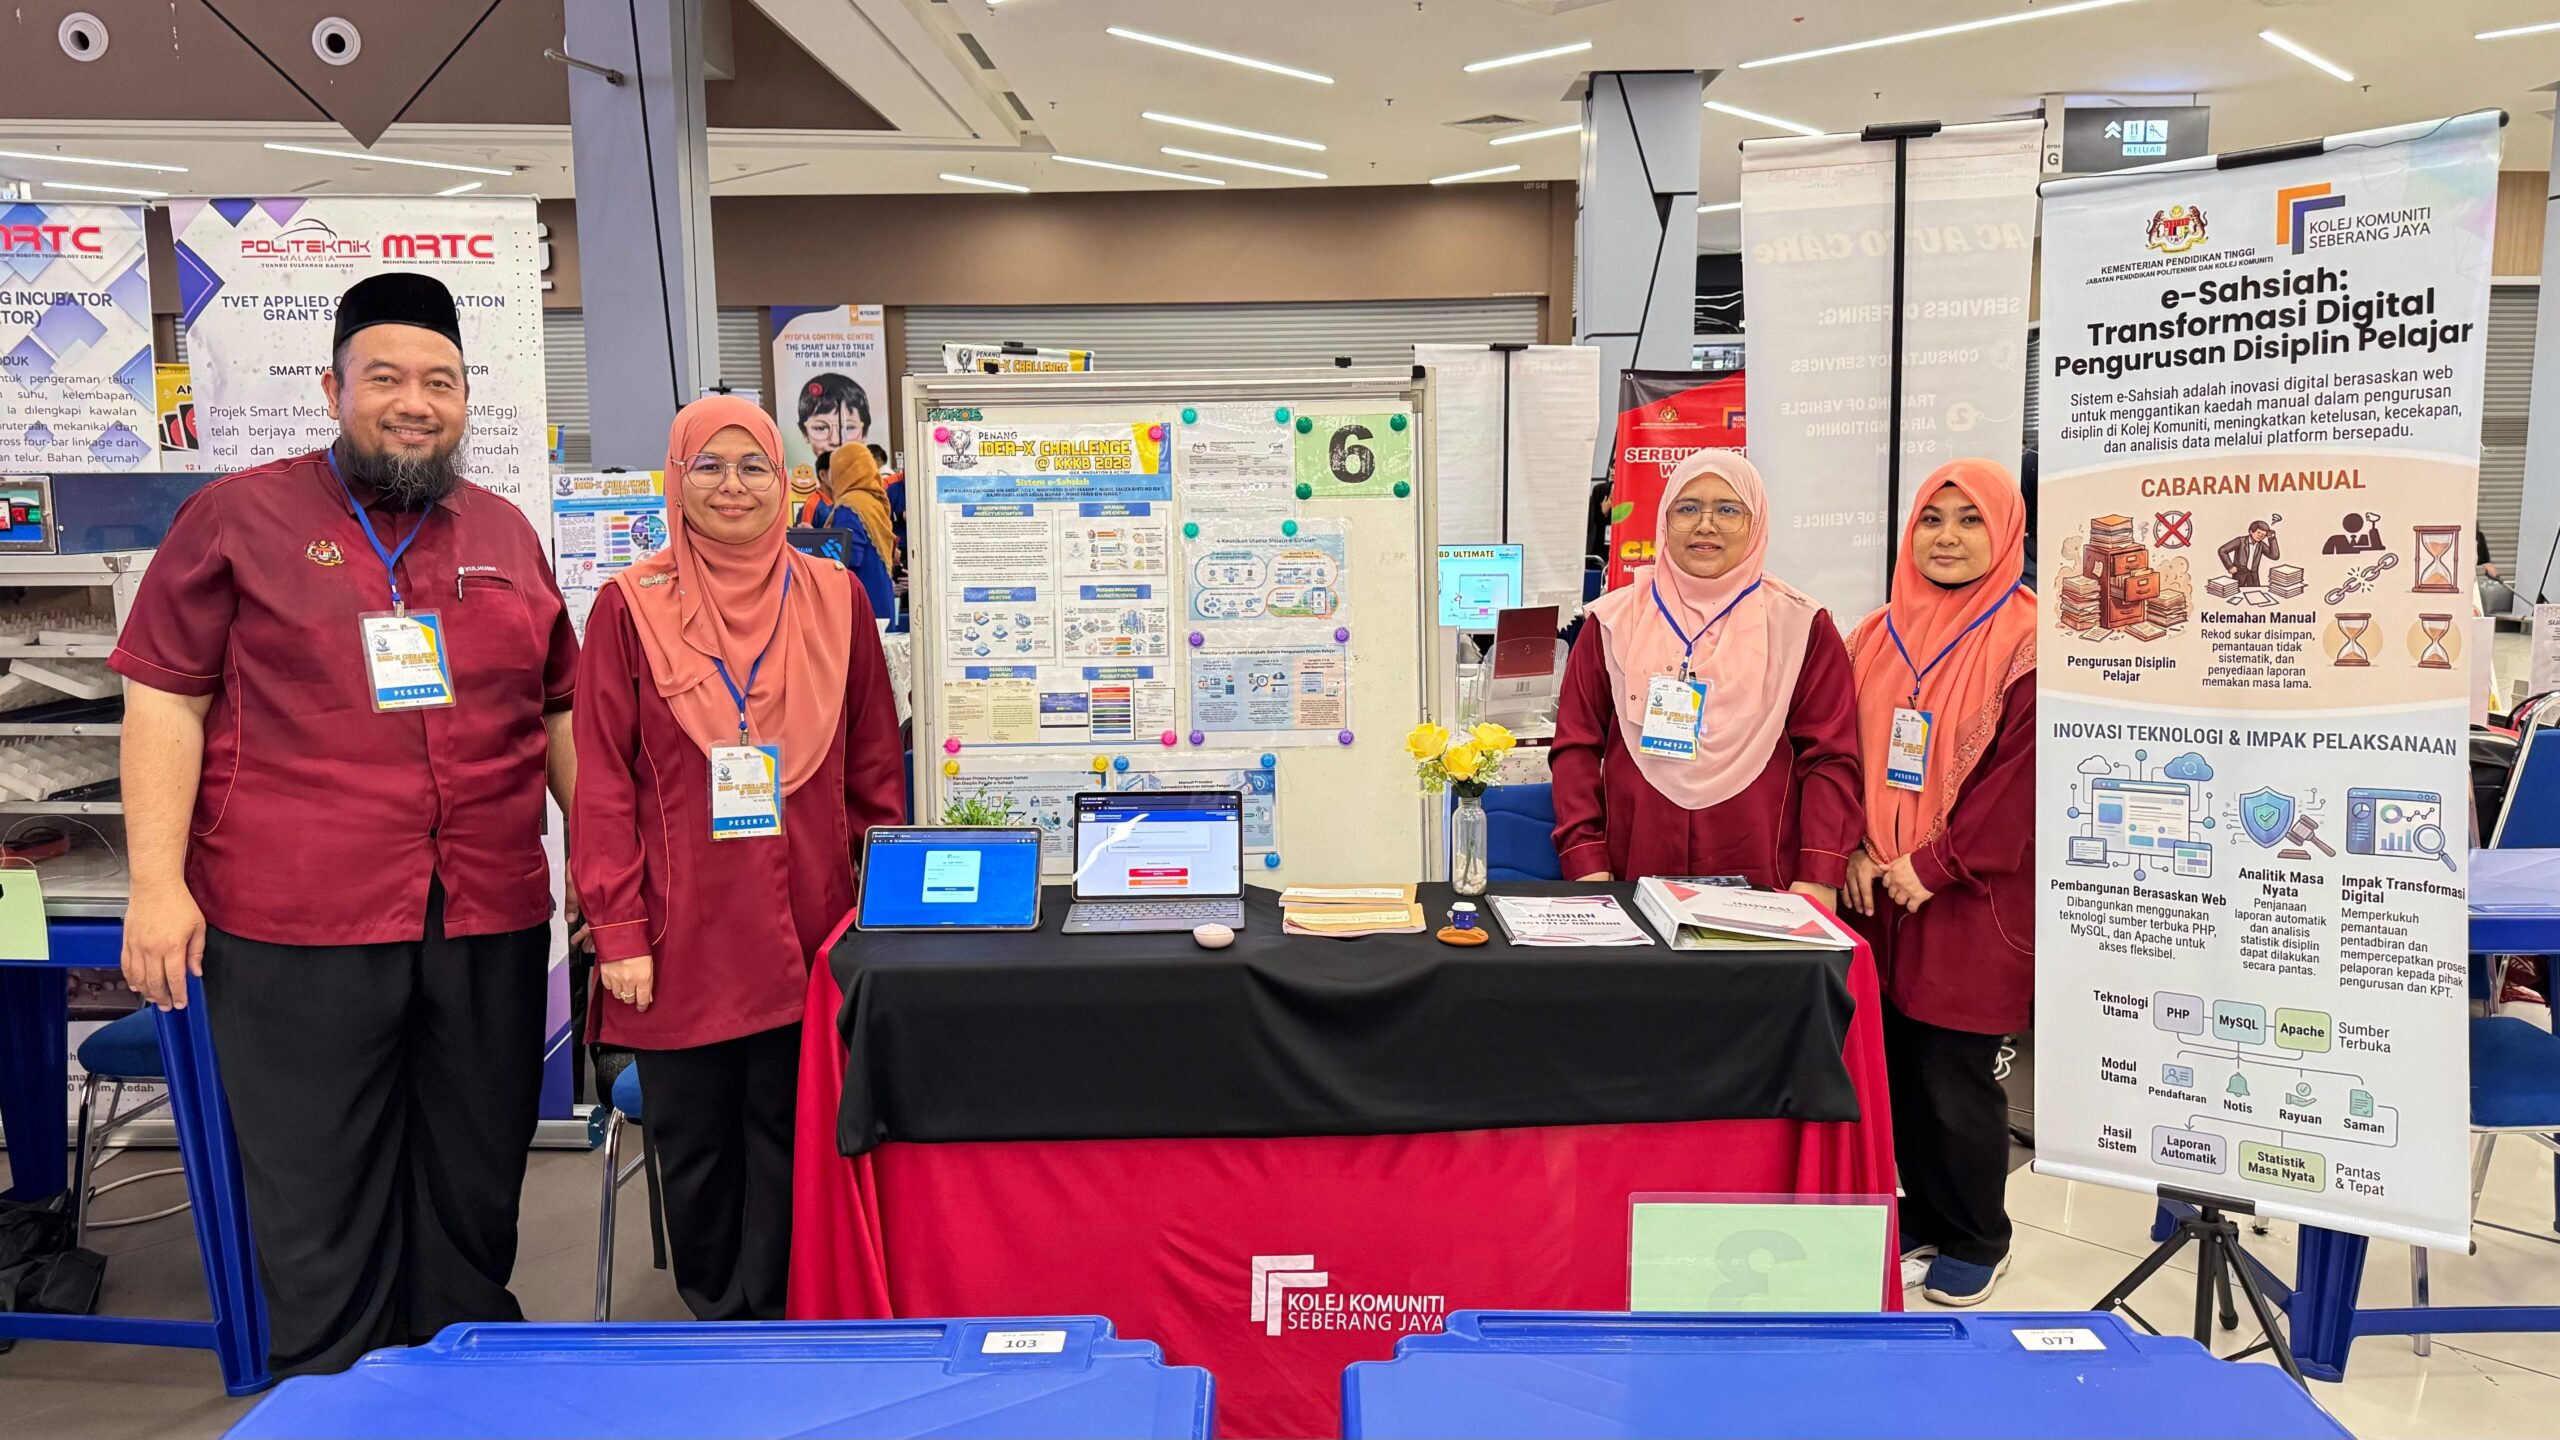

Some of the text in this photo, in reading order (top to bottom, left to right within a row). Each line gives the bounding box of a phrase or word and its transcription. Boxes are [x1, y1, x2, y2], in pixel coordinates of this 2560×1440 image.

[2127, 146, 2161, 154] KELUAR
[2047, 153, 2059, 165] G
[2309, 206, 2431, 236] KOLEJ KOMUNITI
[2309, 221, 2431, 249] SEBERANG JAYA
[383, 234, 494, 258] MRTC
[2100, 247, 2256, 275] KEMENTERIAN PENDIDIKAN TINGGI
[2085, 274, 2115, 285] JABATAN
[2115, 269, 2156, 282] PENDIDIKAN
[2198, 263, 2213, 272] DAN
[2215, 260, 2237, 271] KOLEJ
[2238, 255, 2274, 269] KOMUNITI
[2161, 266, 2348, 310] e-Sahsiah:
[16, 291, 112, 307] INCUBATOR
[222, 296, 329, 307] TVET APPLIED
[264, 310, 318, 321] GRANT
[2087, 287, 2435, 348] Transformasi Digital
[785, 333, 874, 341] MYOPIA CONTROL CENTRE
[2054, 319, 2474, 380] Pengurusan Disiplin Pelajar
[269, 366, 312, 376] SMART
[30, 375, 136, 389] pengeraman telur
[2070, 365, 2454, 407] Sistem e-Sahsiah adalah inovasi digital berasaskan web
[18, 390, 136, 405] suhu, kelembapan,
[24, 406, 137, 419] dilengkapi kawalan
[210, 405, 290, 420] Projek Smart
[53, 422, 109, 432] mekanikal
[211, 425, 239, 436] telah
[249, 425, 296, 439] berjaya
[979, 431, 1018, 440] PENANG
[24, 437, 112, 451] four-bar linkage
[213, 444, 519, 456] kecil mudah
[979, 440, 1132, 456] IDEA-X CHALLENGE
[1329, 424, 1375, 483] 6
[1035, 457, 1131, 471] @ KKKB 2026
[2141, 469, 2366, 499] CABARAN MANUAL
[2200, 610, 2316, 625] Kelemahan Manual
[2067, 655, 2176, 671] Pengurusan Disiplin
[2102, 669, 2141, 684] Pelajar
[394, 687, 439, 696] PESERTA
[2053, 722, 2457, 756] INOVASI TEKNOLOGI & IMPAK PELAKSANAAN
[1894, 772, 1919, 781] PESERTA
[729, 818, 770, 826] PESERTA
[2239, 867, 2324, 886] Analitik Masa
[2050, 879, 2227, 906] Pembangunan Berasaskan Web
[2262, 882, 2299, 898] Nyata
[2341, 875, 2466, 900] Impak Transformasi
[2341, 889, 2384, 905] Digital
[2093, 990, 2149, 1008] Teknologi
[2102, 1005, 2139, 1020] Utama
[2166, 1007, 2190, 1020] PHP
[2219, 1015, 2259, 1031] MySQL
[2280, 1023, 2325, 1039] Apache
[2338, 1022, 2390, 1039] Sumber
[2339, 1035, 2391, 1054] Terbuka
[2101, 1057, 2137, 1072] Modul
[2100, 1071, 2137, 1086] Utama
[2148, 1085, 2207, 1105] Pendaftaran
[2224, 1099, 2253, 1114] Notis
[2279, 1109, 2322, 1126] Rayuan
[2343, 1117, 2385, 1134] Saman
[2103, 1125, 2132, 1140] Hasil
[2097, 1138, 2137, 1155] Sistem
[2167, 1135, 2211, 1153] Laporan
[2160, 1145, 2217, 1165] Automatik
[2257, 1150, 2306, 1170] Statistik
[2248, 1162, 2315, 1185] Masa Nyata
[2336, 1163, 2381, 1180] Pantas
[2336, 1177, 2385, 1197] & Tepat
[1288, 1294, 1444, 1313] KOLEJ KOMUNITI
[1288, 1313, 1443, 1332] SEBERANG JAYA
[1004, 1340, 1037, 1348] 103
[2042, 1337, 2073, 1345] 077
